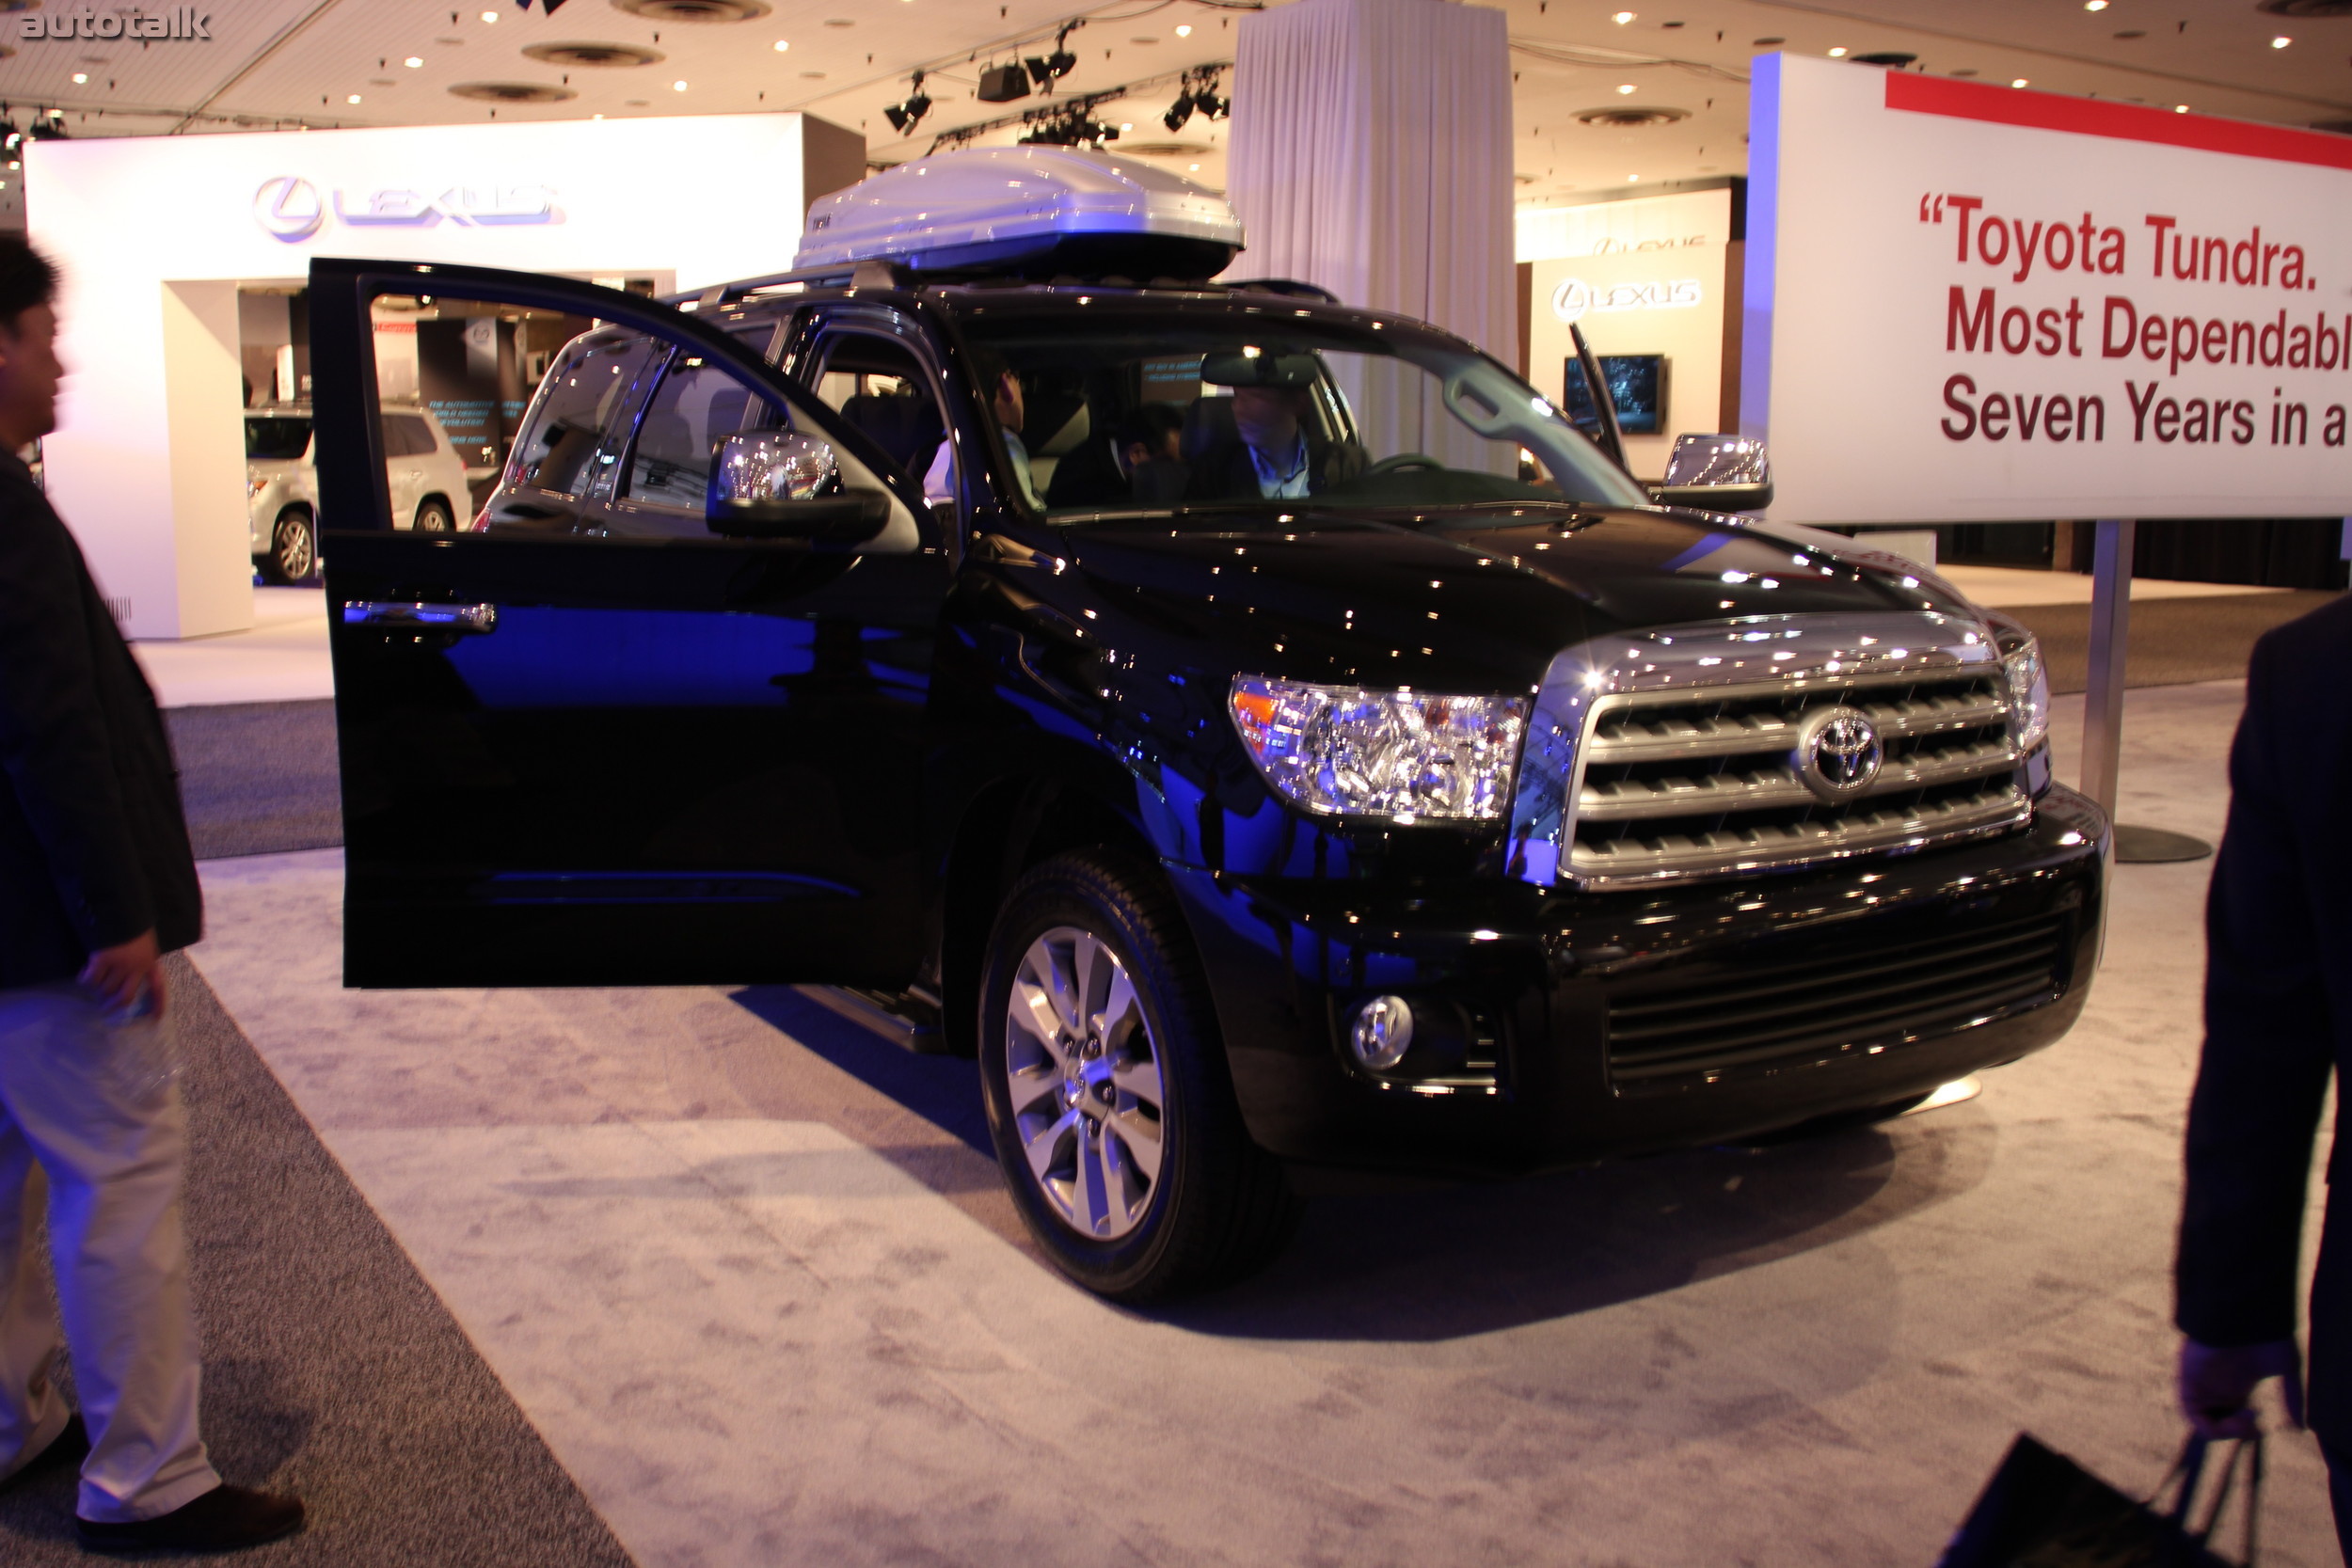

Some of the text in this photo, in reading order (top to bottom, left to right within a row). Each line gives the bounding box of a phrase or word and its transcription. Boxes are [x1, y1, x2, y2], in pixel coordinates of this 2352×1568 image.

[331, 184, 566, 228] LEXUS
[2145, 214, 2317, 292] Tundra.
[1590, 282, 1699, 309] LEXUS
[1946, 285, 2352, 377] Most Dependabl
[1940, 372, 2346, 447] Seven Years in a
